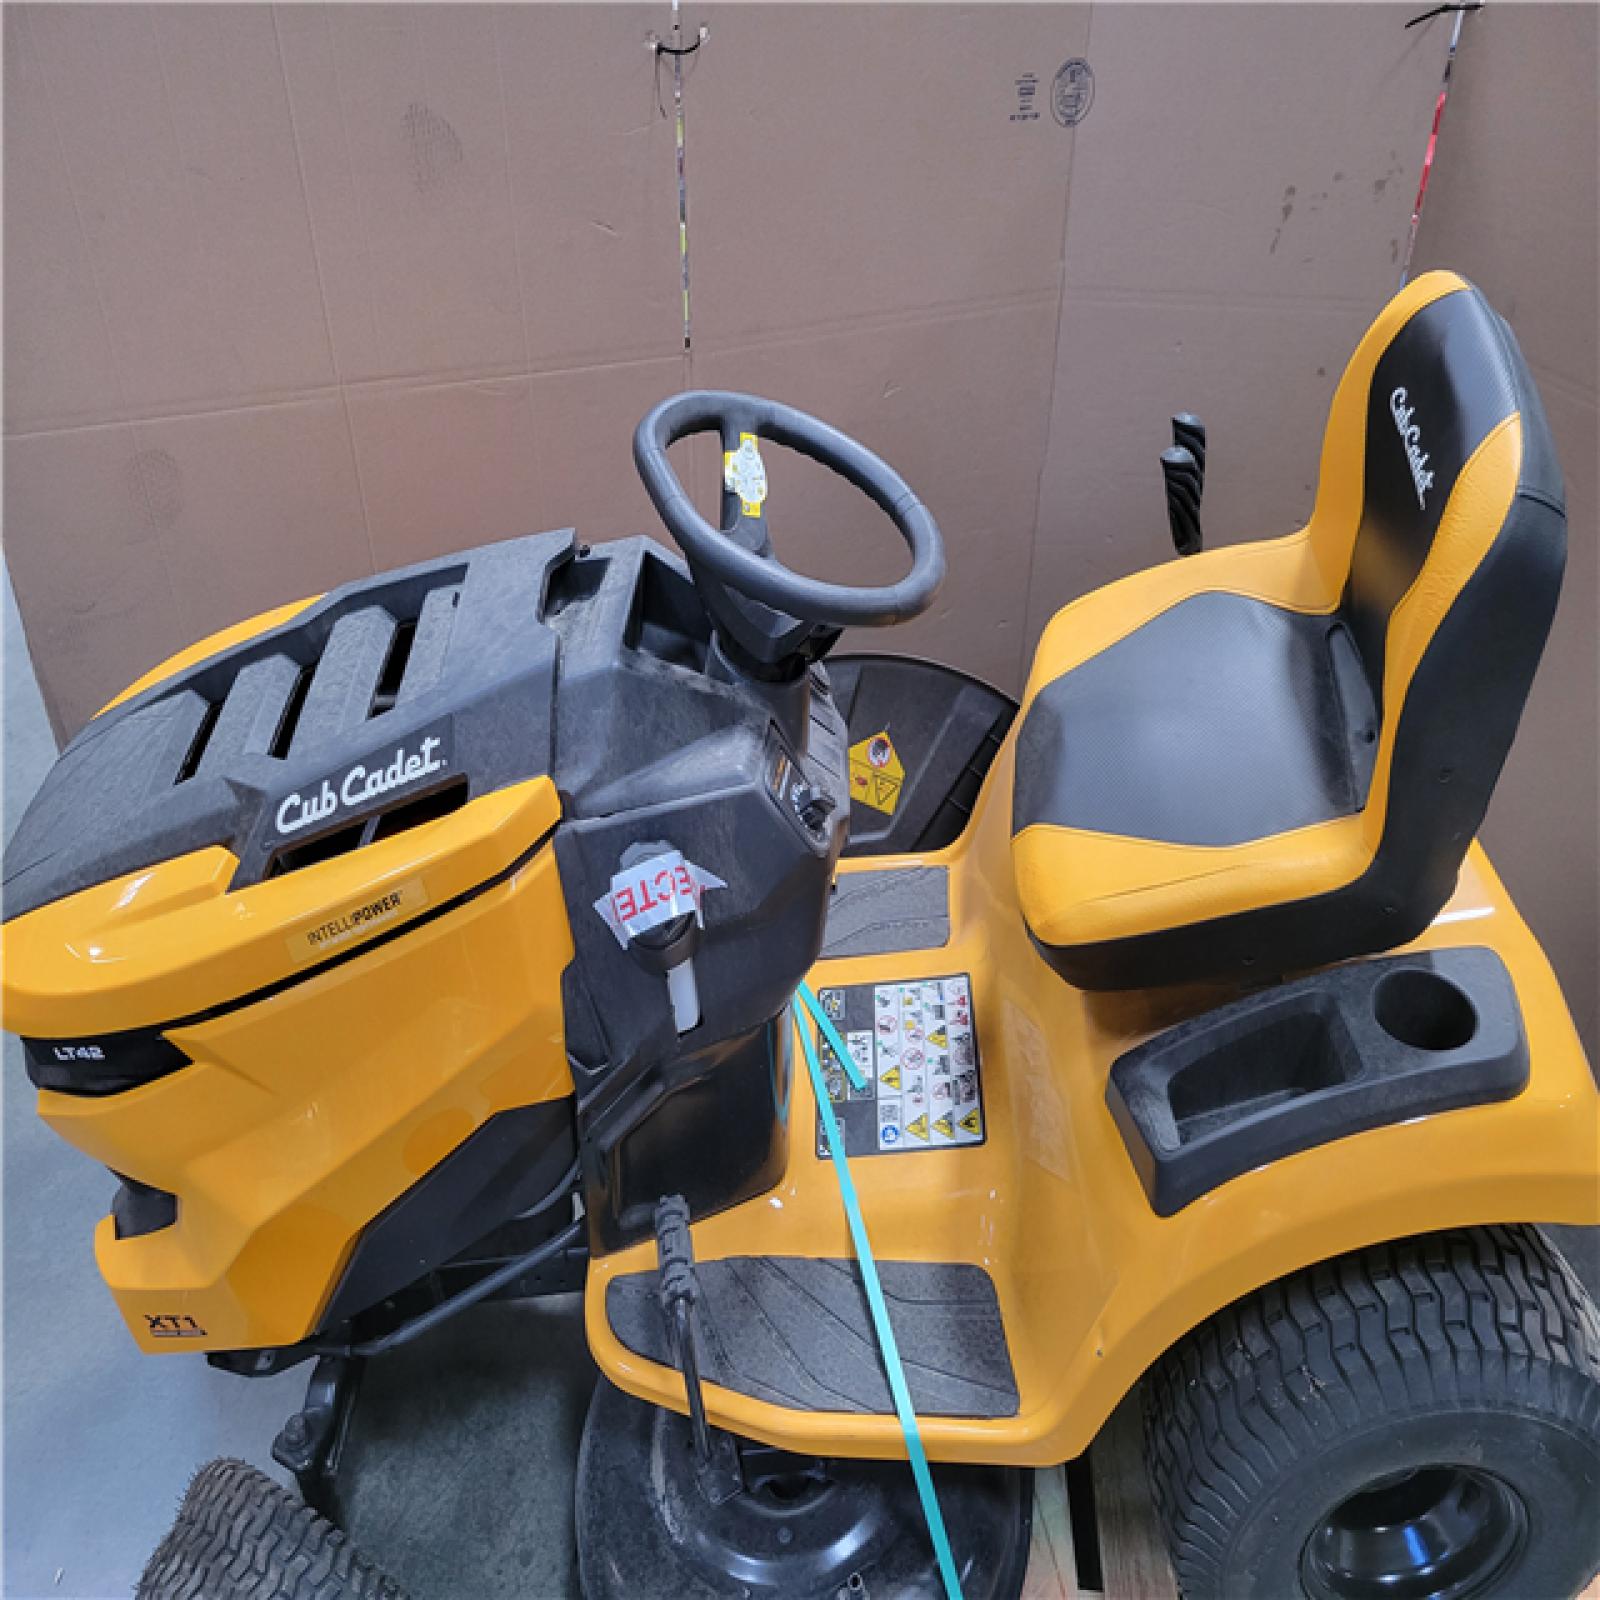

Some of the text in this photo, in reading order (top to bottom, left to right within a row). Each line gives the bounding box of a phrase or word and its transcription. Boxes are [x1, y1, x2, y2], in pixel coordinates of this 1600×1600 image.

[276, 737, 441, 834] Cub Cadet
[53, 1046, 106, 1061] LT42
[144, 1314, 198, 1329] XT1
